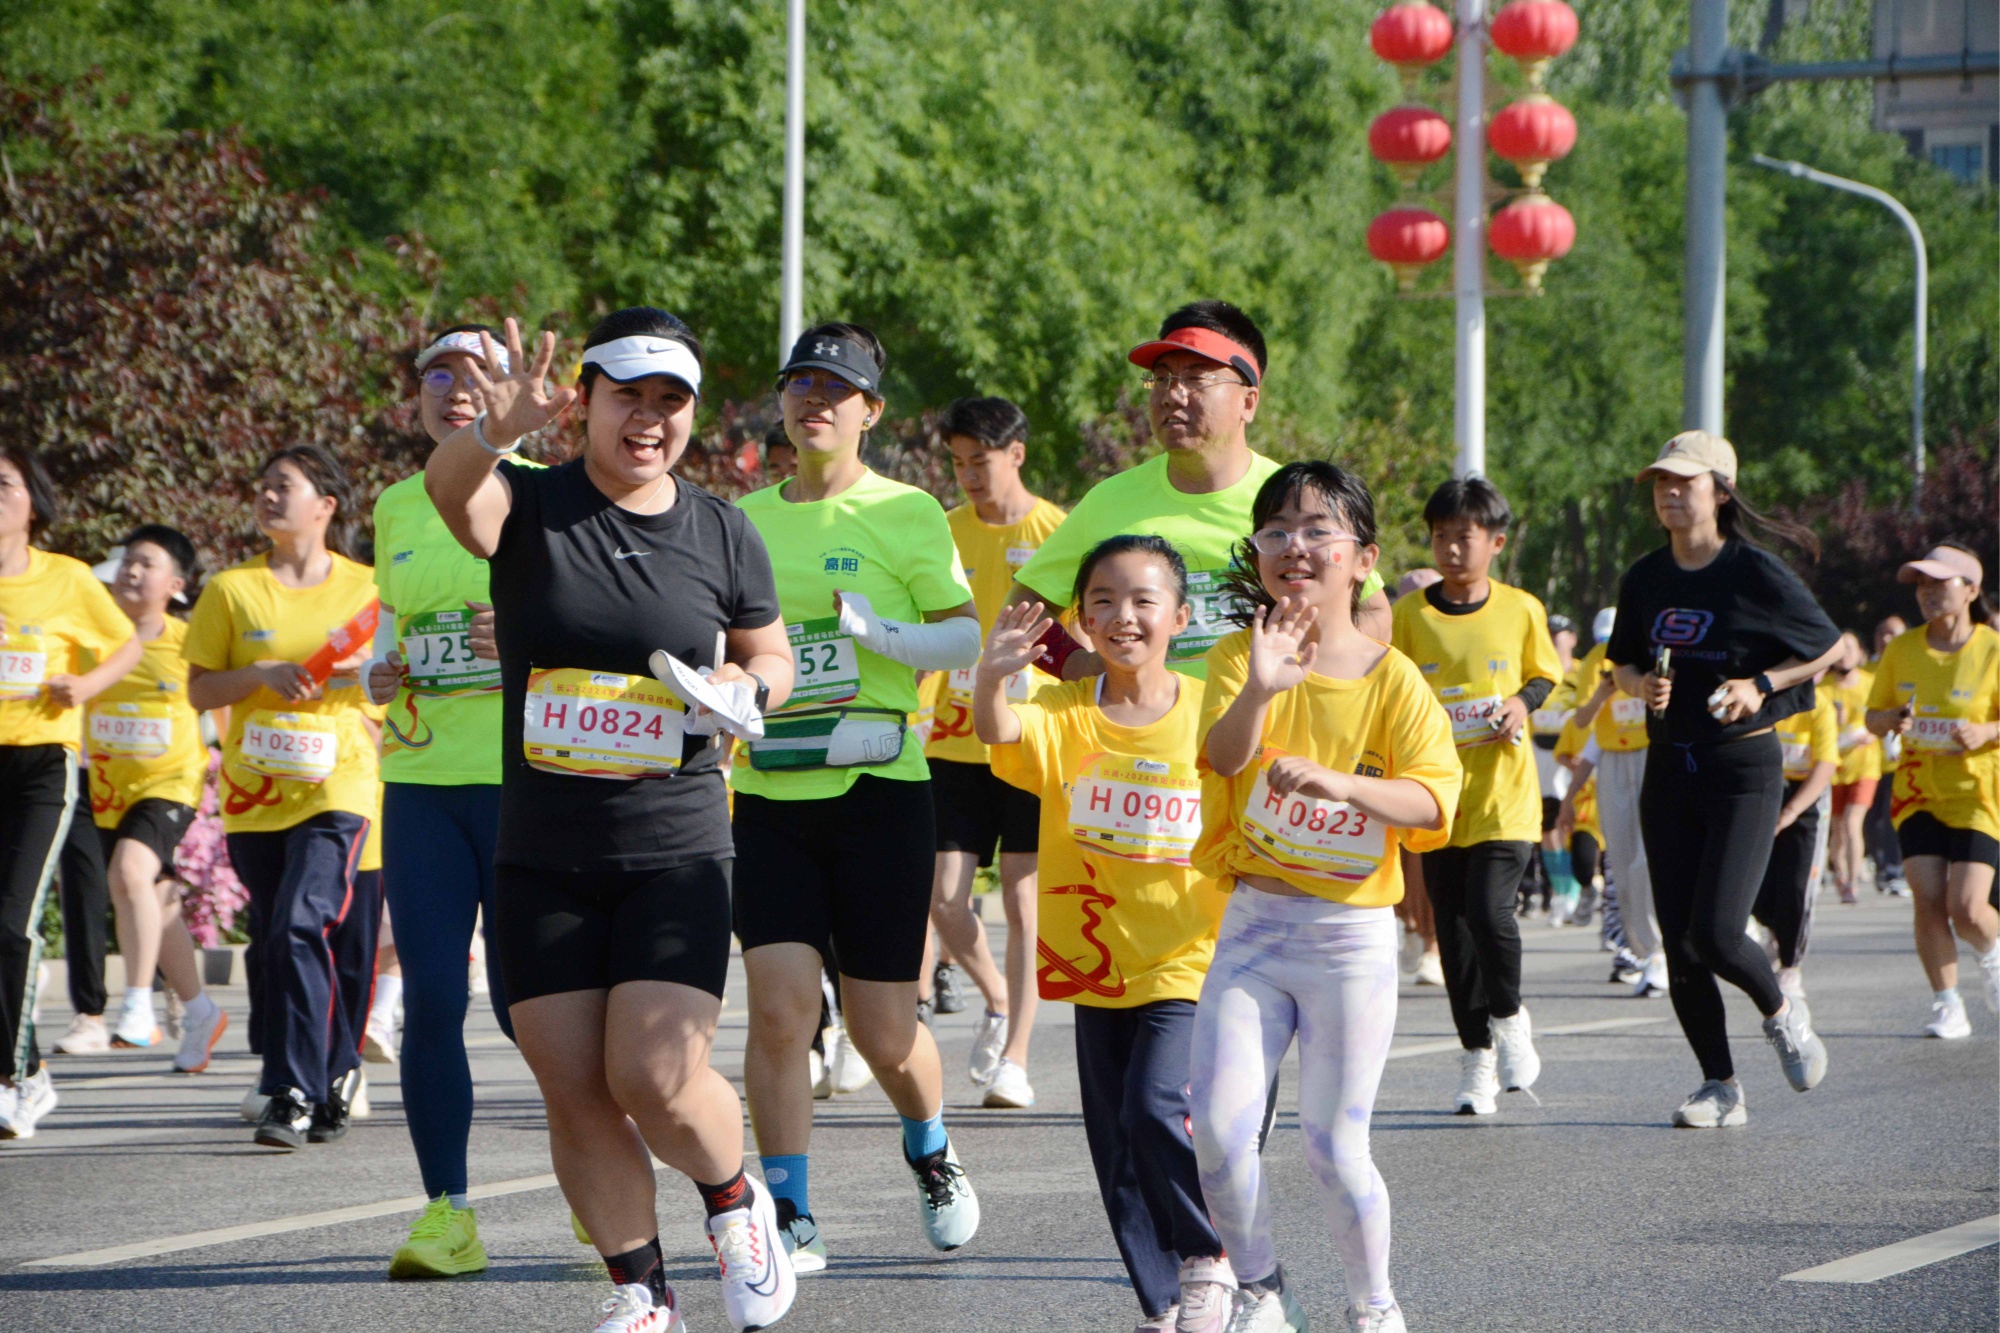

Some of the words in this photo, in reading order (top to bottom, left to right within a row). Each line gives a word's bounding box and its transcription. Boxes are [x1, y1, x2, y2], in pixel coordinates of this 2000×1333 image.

[824, 557, 858, 572] 高阳
[97, 720, 109, 733] H
[114, 721, 160, 736] 0722
[543, 702, 567, 729] H
[578, 706, 664, 740] 0824
[250, 730, 262, 747] H
[269, 733, 323, 754] 0259
[1090, 785, 1112, 813] H
[1123, 791, 1200, 823] 0907
[1264, 785, 1284, 816] H
[1289, 800, 1368, 836] 0823
